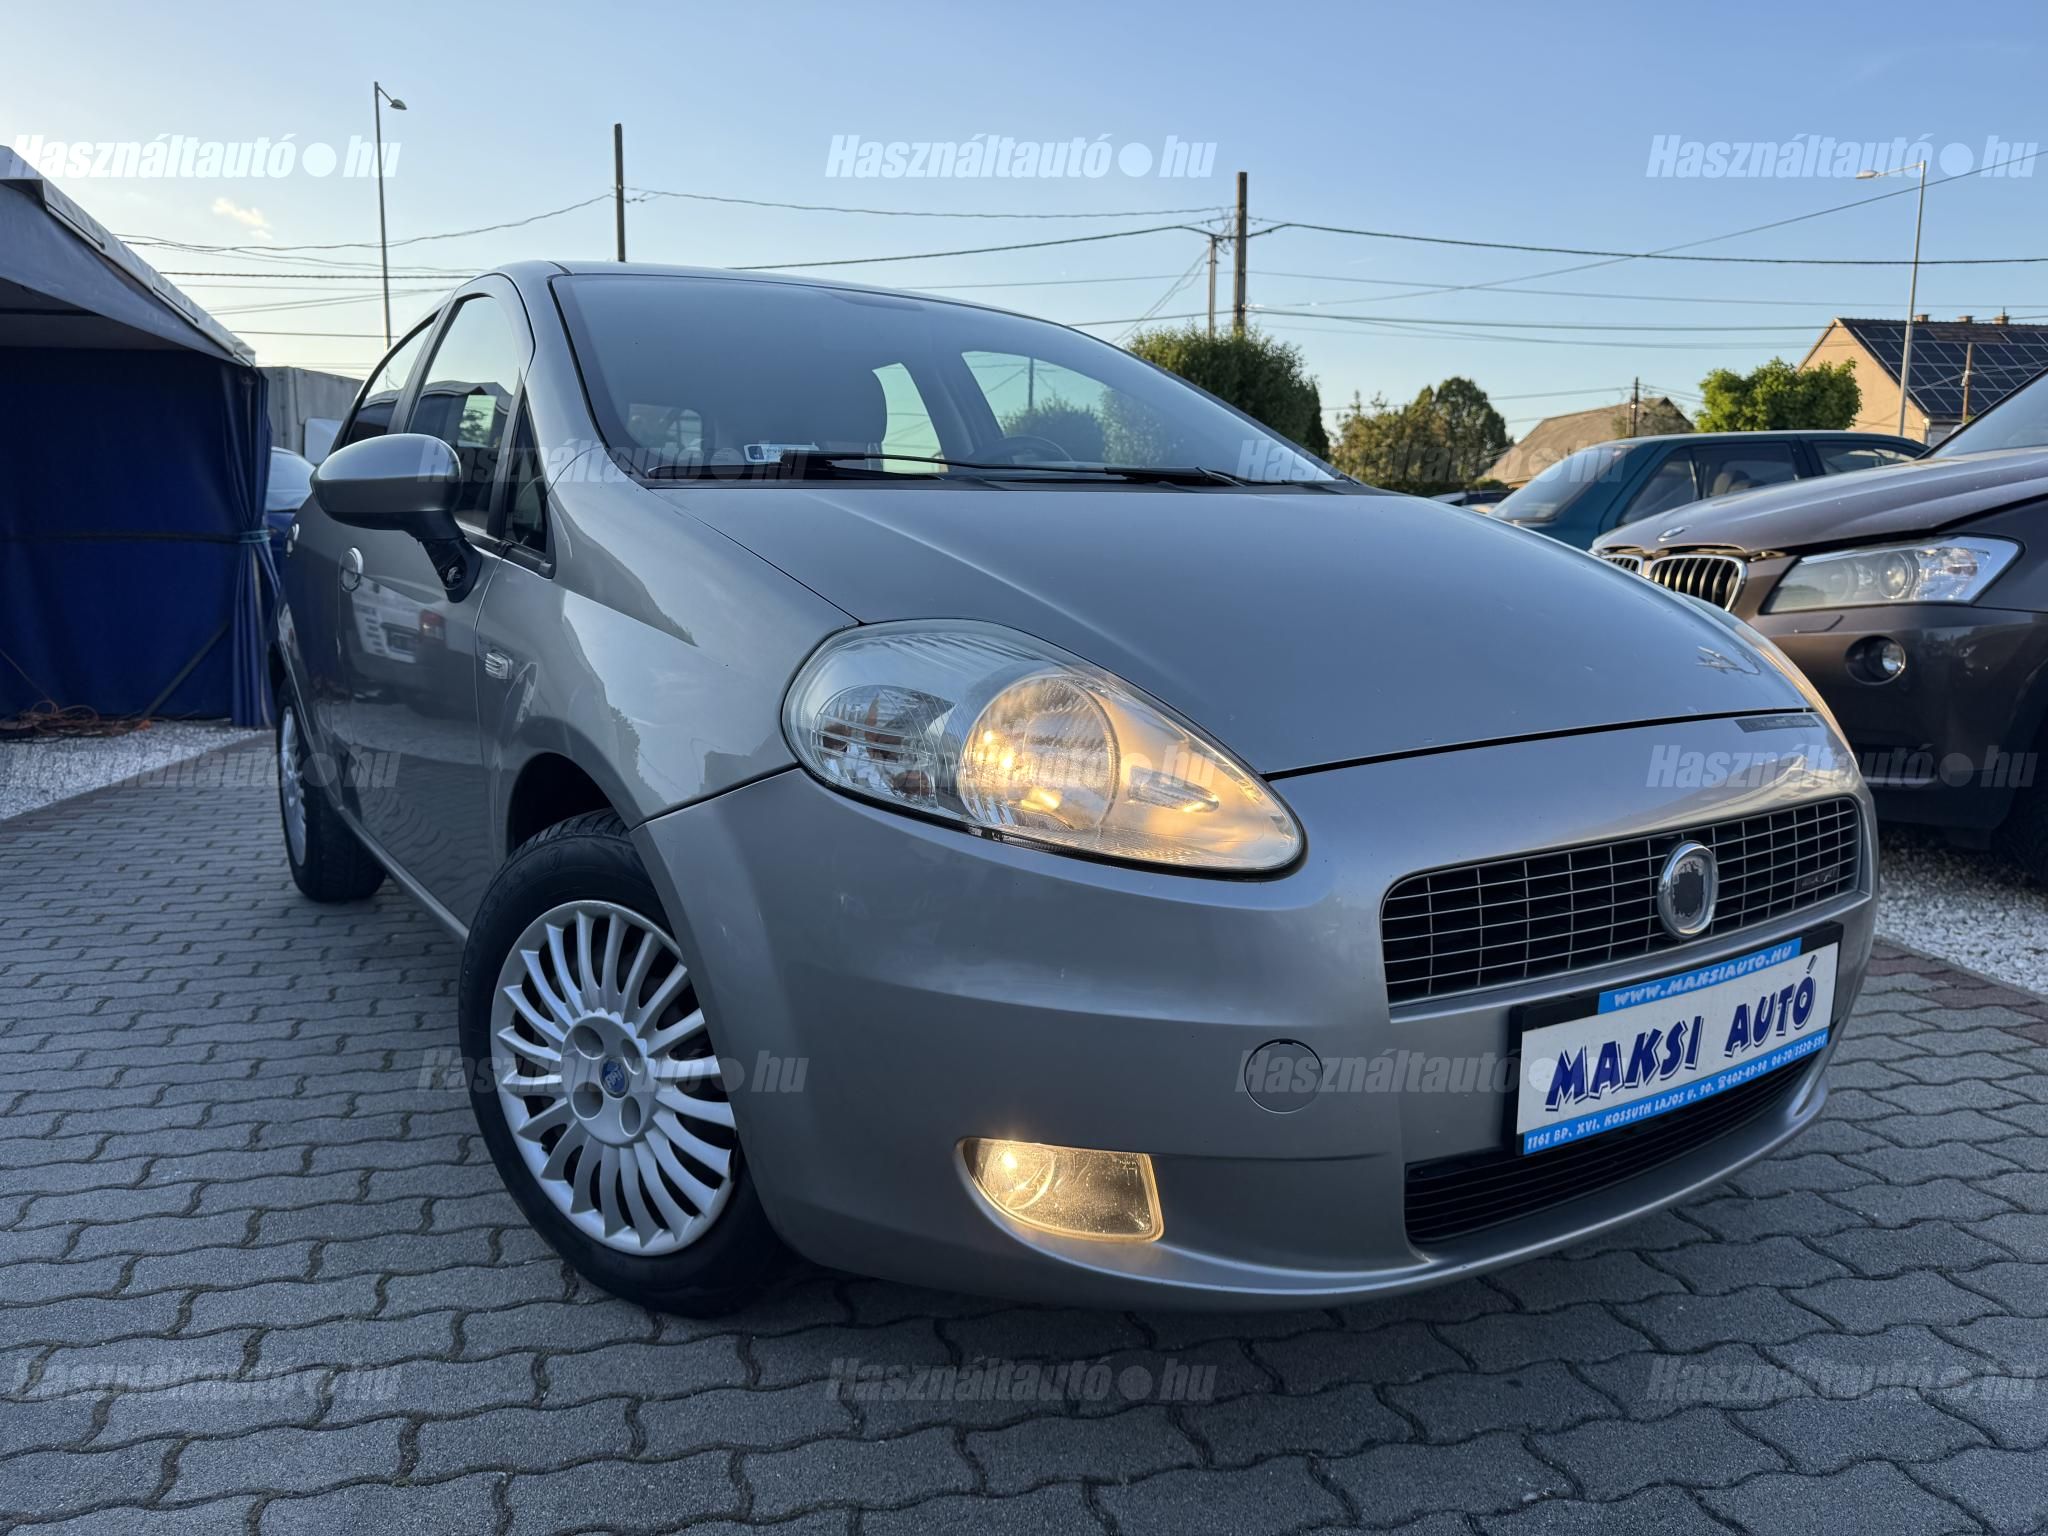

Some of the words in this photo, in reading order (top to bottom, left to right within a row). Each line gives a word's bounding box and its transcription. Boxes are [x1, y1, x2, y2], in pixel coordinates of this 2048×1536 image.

[1613, 946, 1793, 1008] WWW.MAKSIAUTO.HU
[1545, 1015, 1704, 1112] MAKSI
[1724, 955, 1818, 1058] AUTÓ
[1527, 1131, 1551, 1150] 1161
[1553, 1127, 1572, 1142] BP.
[1576, 1118, 1600, 1136] XVI.
[1603, 1101, 1653, 1128] KOSSUTH
[1654, 1091, 1685, 1112] LAJOS
